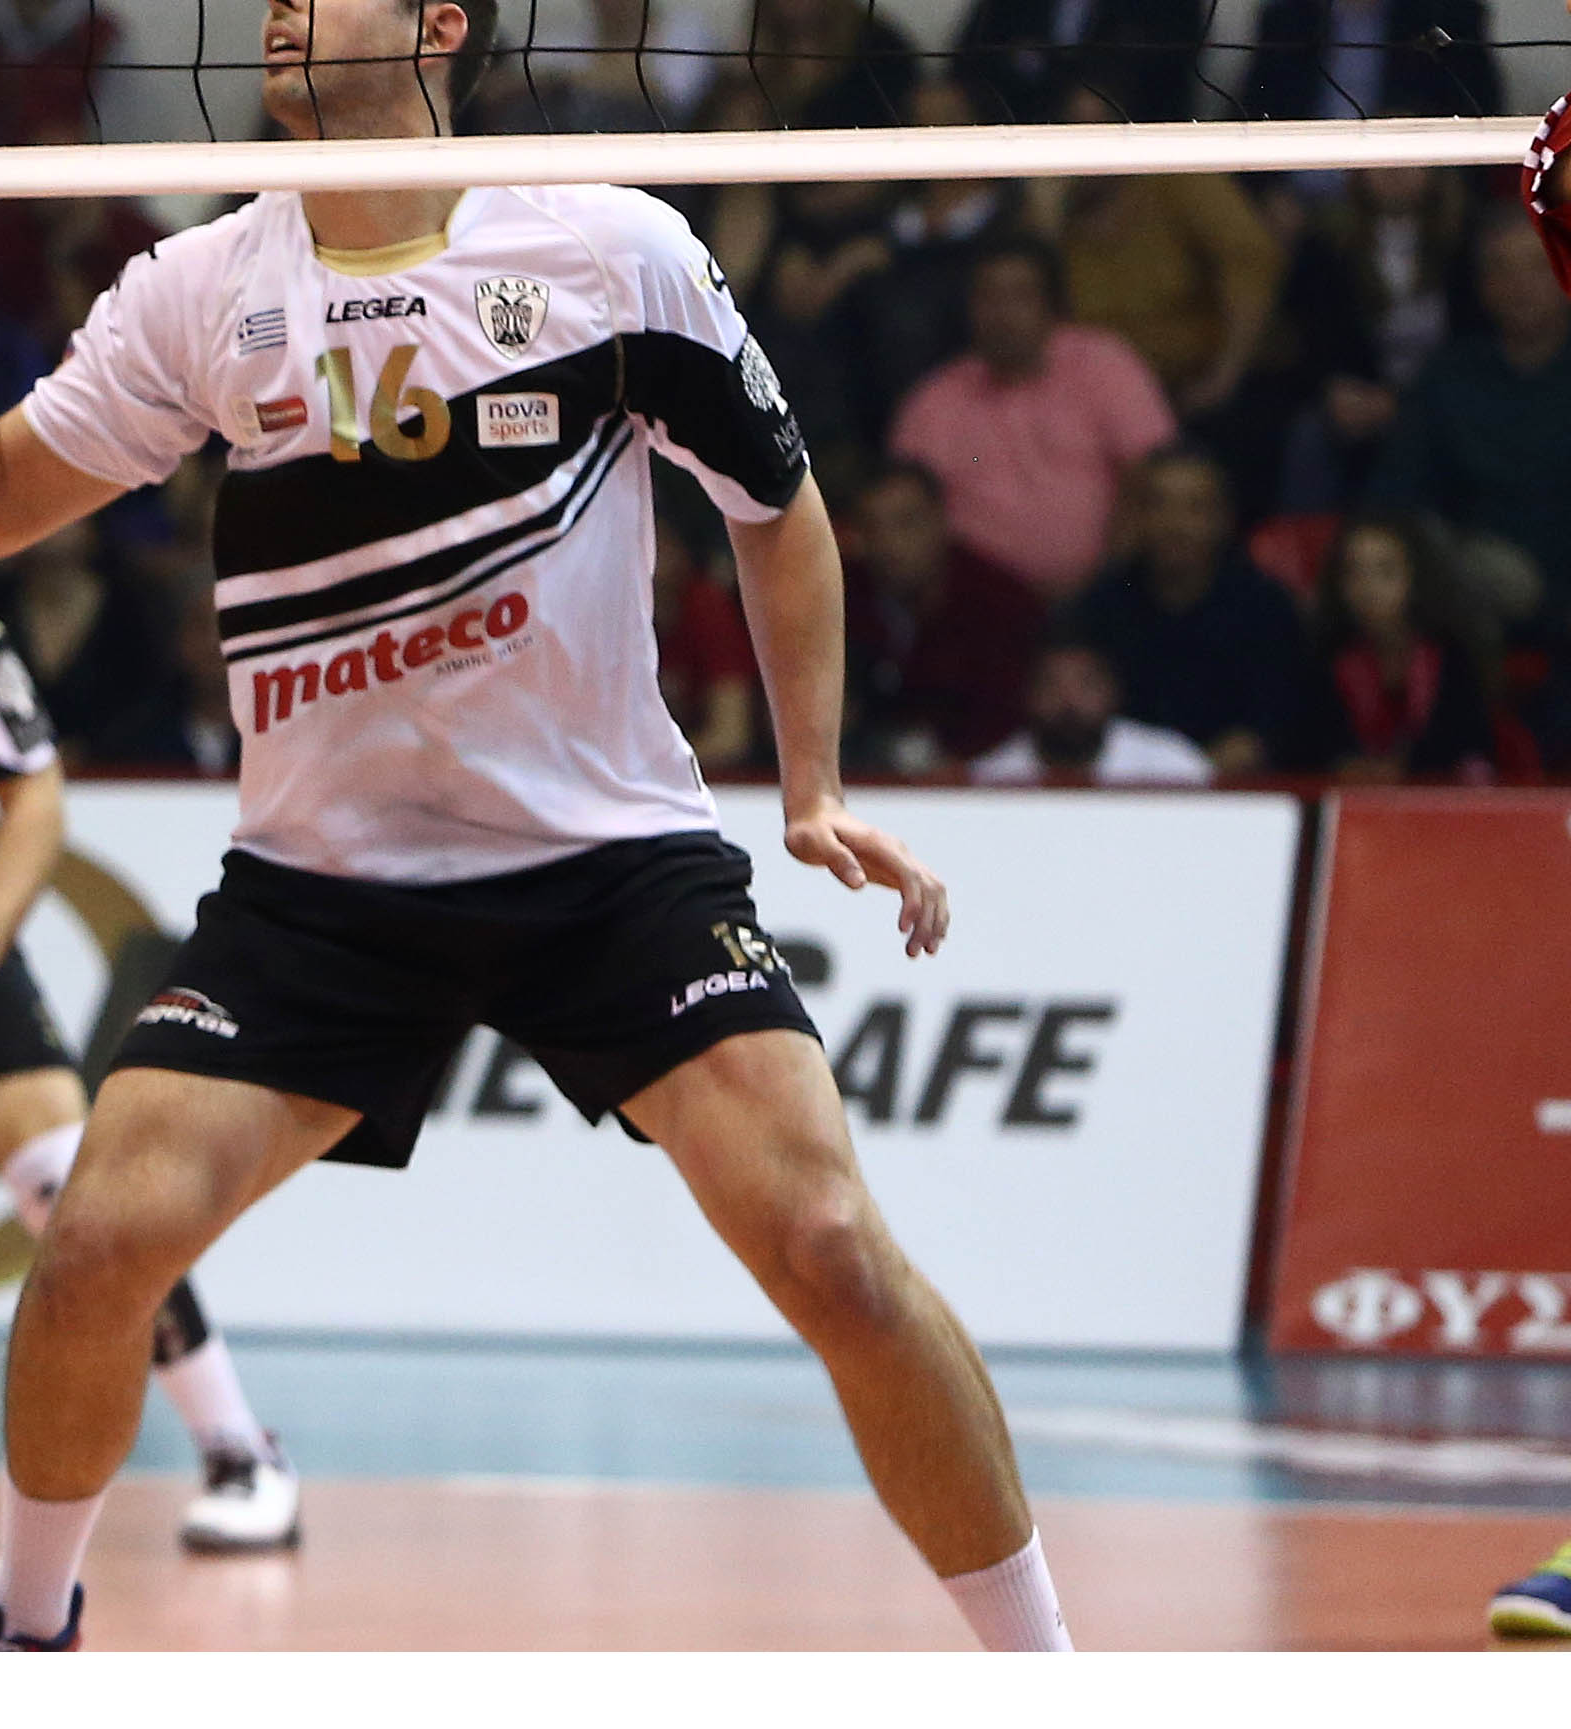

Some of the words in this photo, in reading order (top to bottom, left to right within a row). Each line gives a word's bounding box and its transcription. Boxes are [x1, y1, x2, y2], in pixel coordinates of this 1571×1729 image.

[326, 295, 428, 323] LEGEA
[314, 343, 453, 463] 16
[488, 399, 549, 420] nova
[488, 418, 550, 441] sports
[253, 588, 530, 734] mateco
[670, 969, 770, 1018] LEGEA
